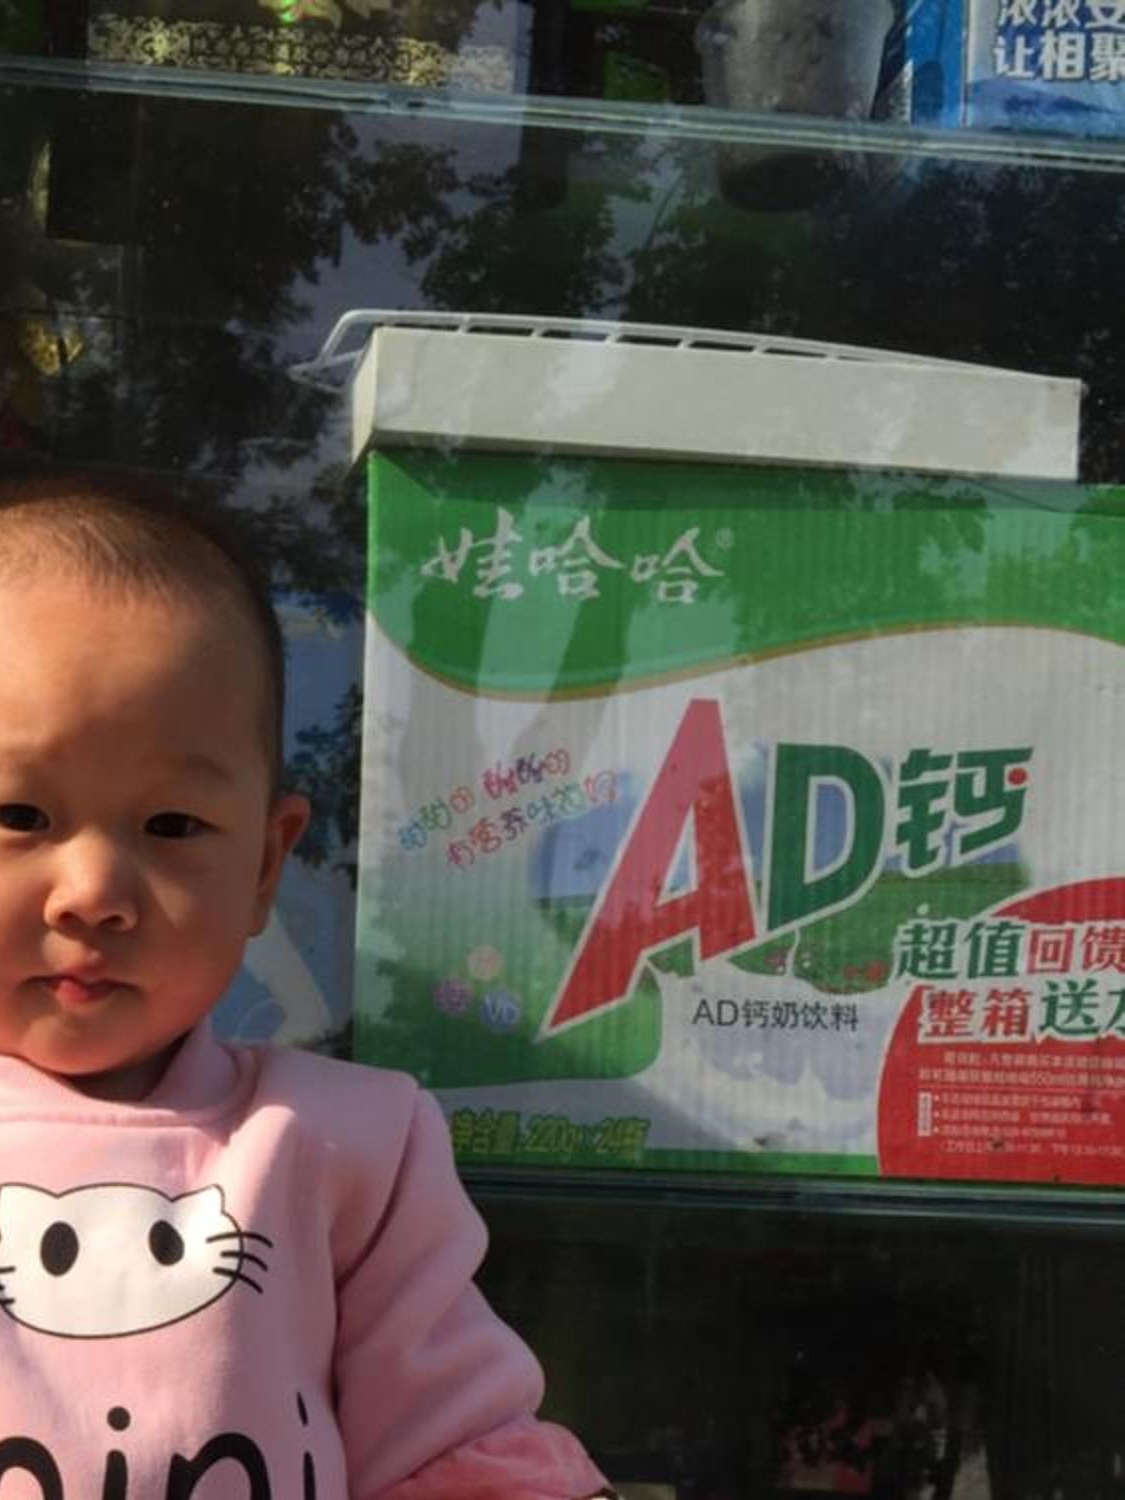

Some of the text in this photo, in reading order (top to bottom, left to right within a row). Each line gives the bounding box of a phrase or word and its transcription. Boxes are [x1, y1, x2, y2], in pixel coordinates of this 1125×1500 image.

[420, 506, 725, 603] 娃哈哈
[896, 921, 1125, 980] 超值回馈
[692, 998, 859, 1032] AD钙奶饮料
